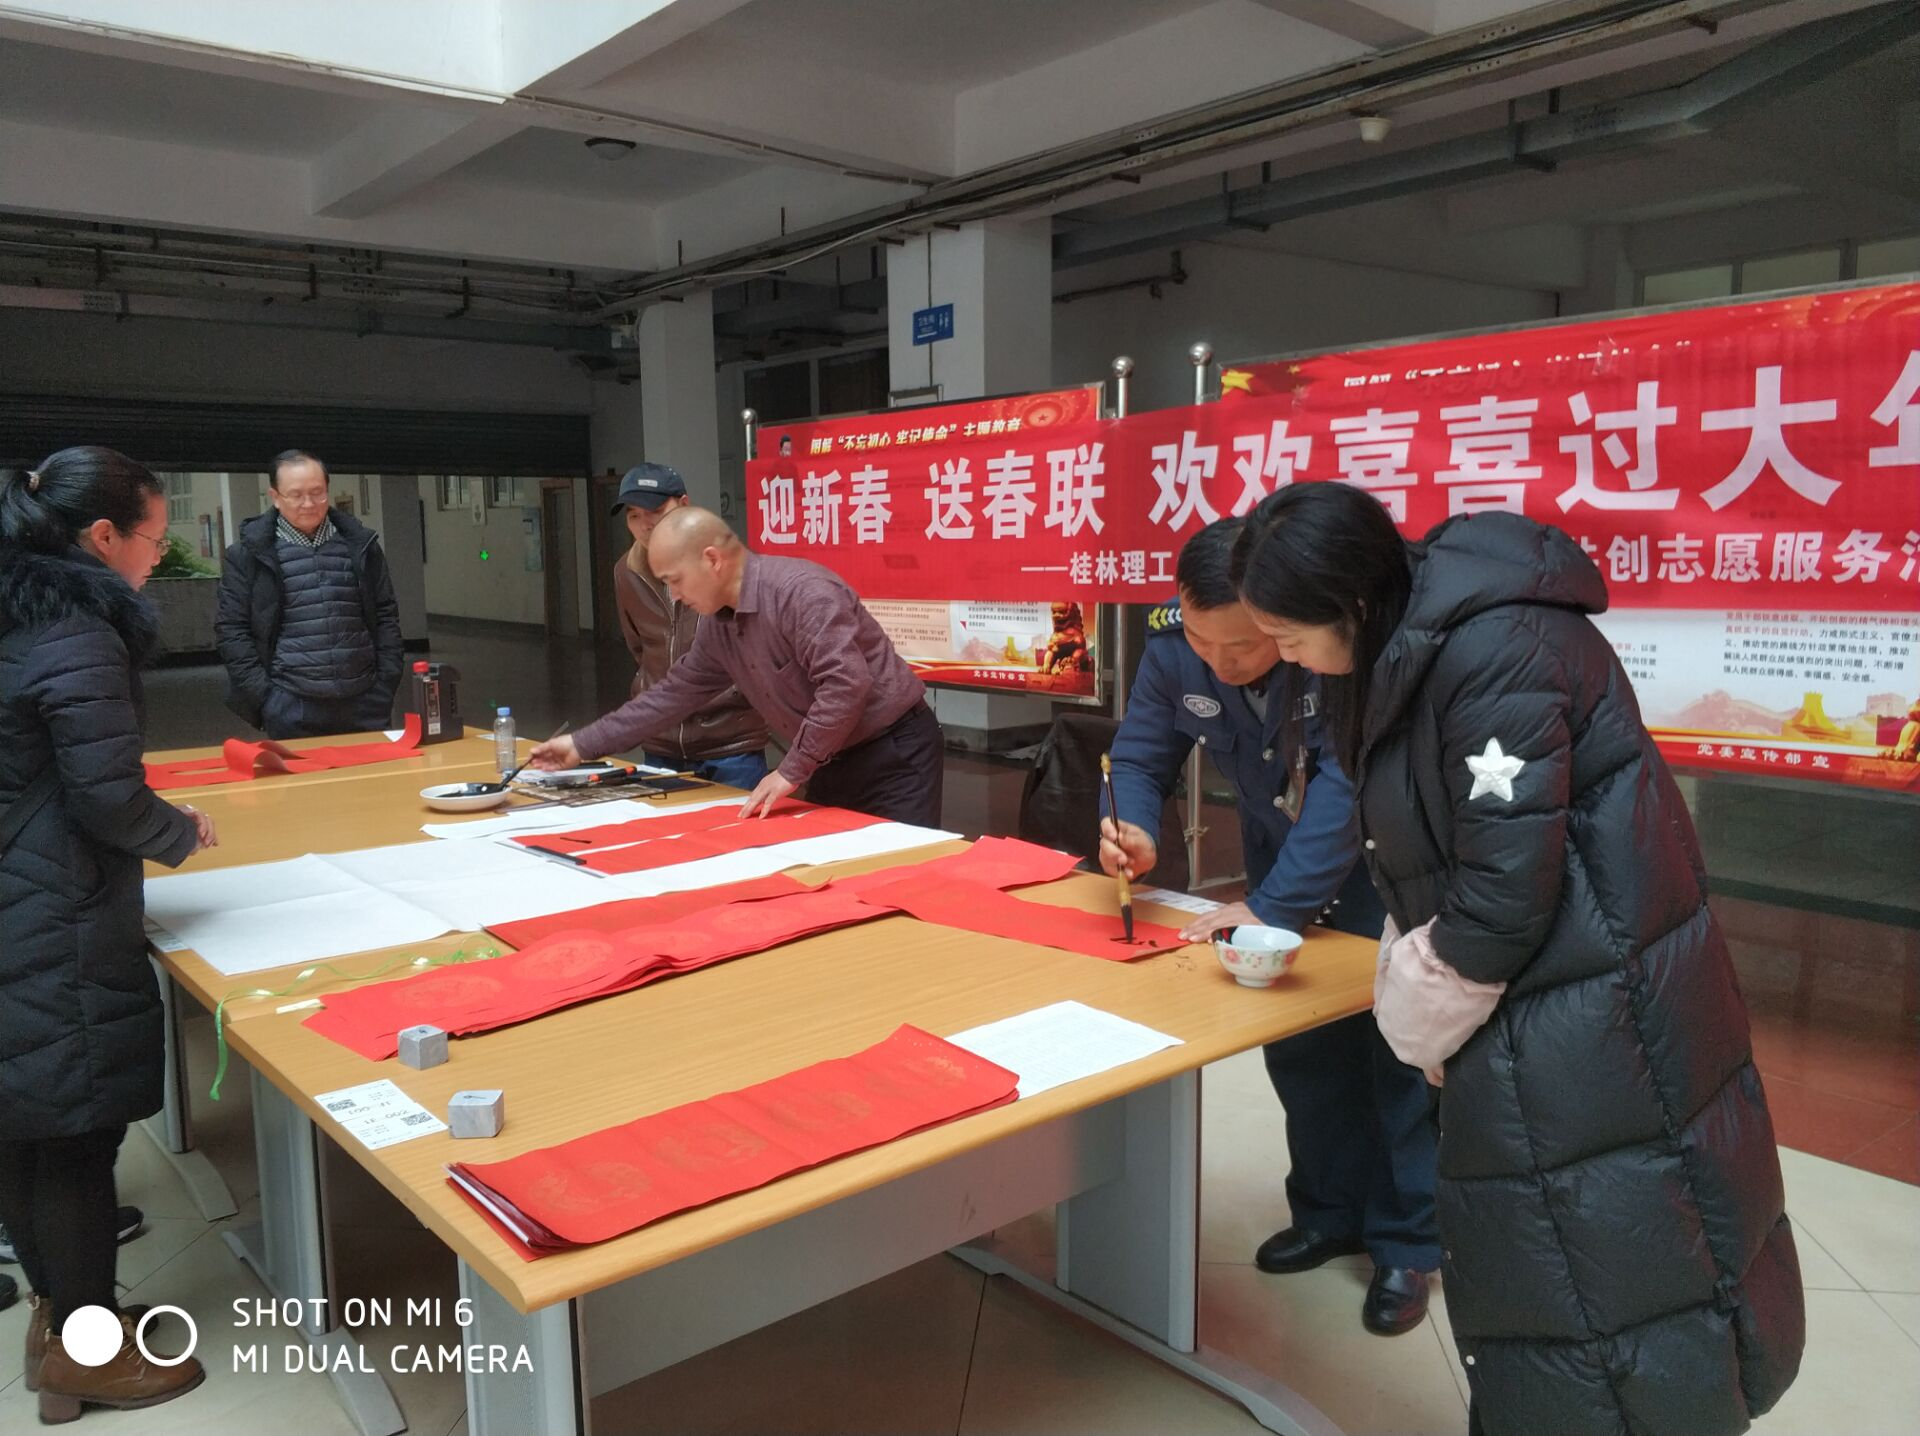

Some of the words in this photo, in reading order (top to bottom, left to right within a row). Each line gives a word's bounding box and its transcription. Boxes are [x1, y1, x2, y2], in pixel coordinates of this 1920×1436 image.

[758, 464, 893, 545] 迎新春
[924, 442, 1106, 541] 送春联
[1572, 529, 1920, 584] 创志愿服务
[1697, 743, 1802, 765] 党委宣传部
[1811, 754, 1830, 769] 宣
